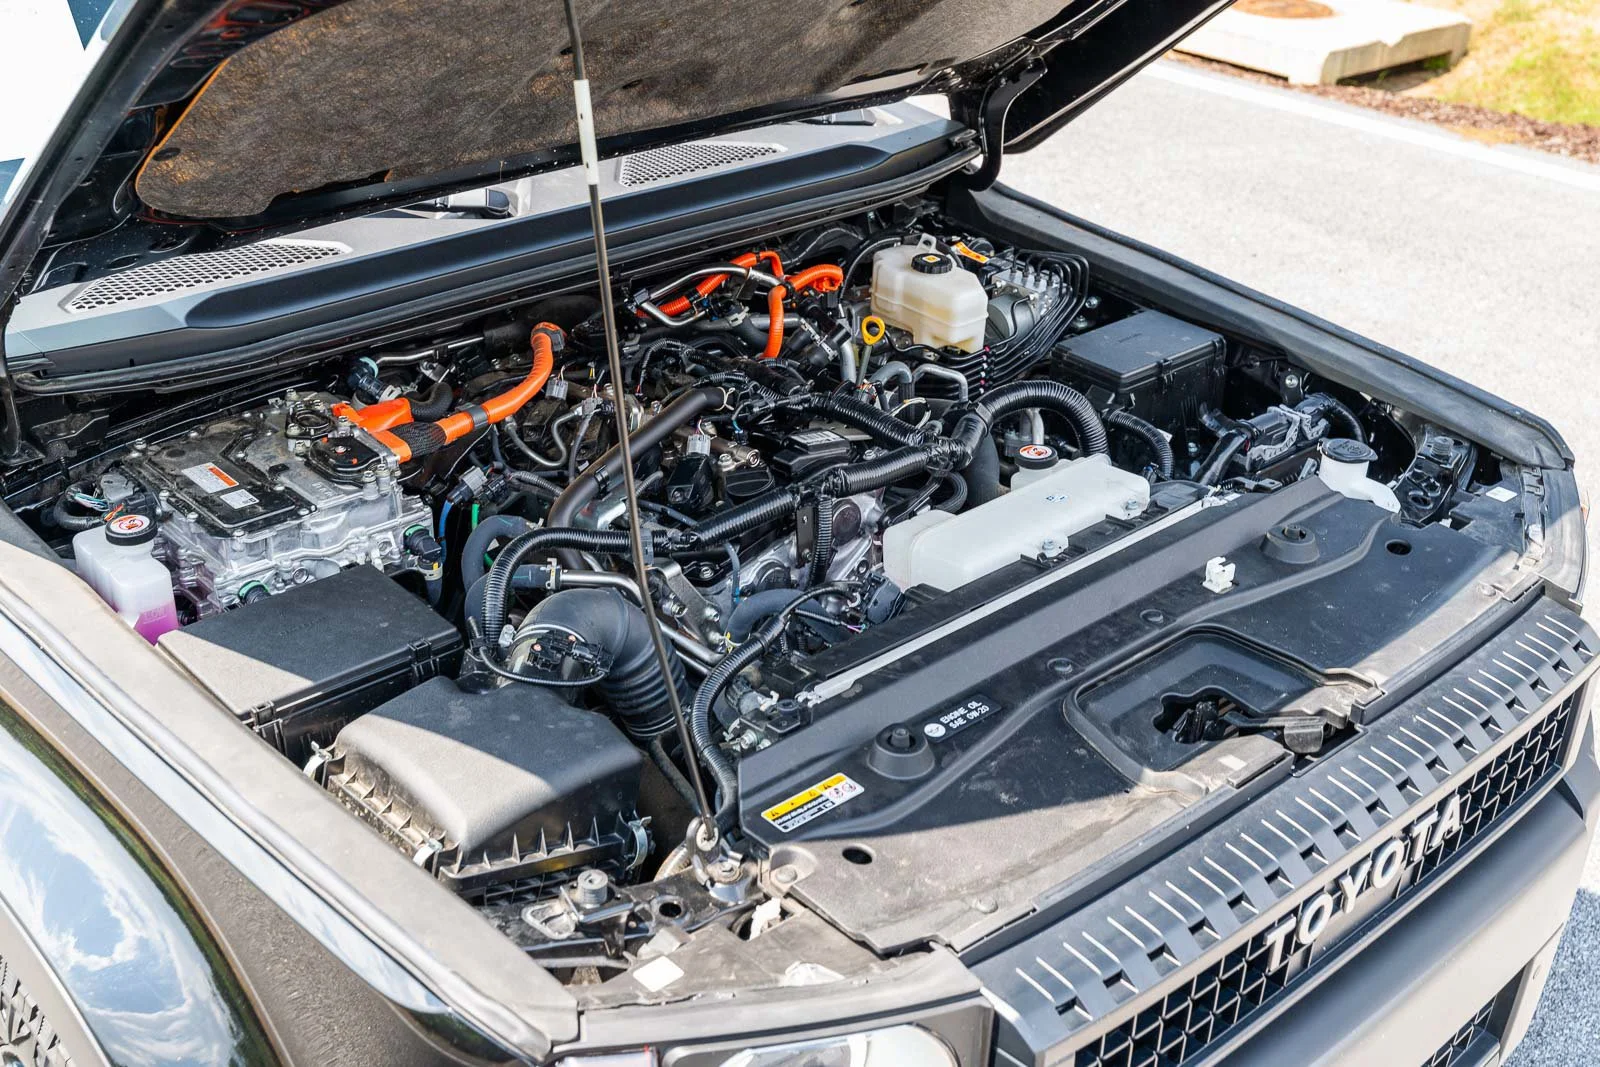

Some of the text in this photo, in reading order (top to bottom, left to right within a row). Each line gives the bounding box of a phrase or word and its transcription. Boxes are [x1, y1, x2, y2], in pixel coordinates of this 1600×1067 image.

[940, 701, 982, 724] ENGINE OIL
[949, 717, 967, 728] SAE
[1264, 794, 1462, 972] TOYOTA
